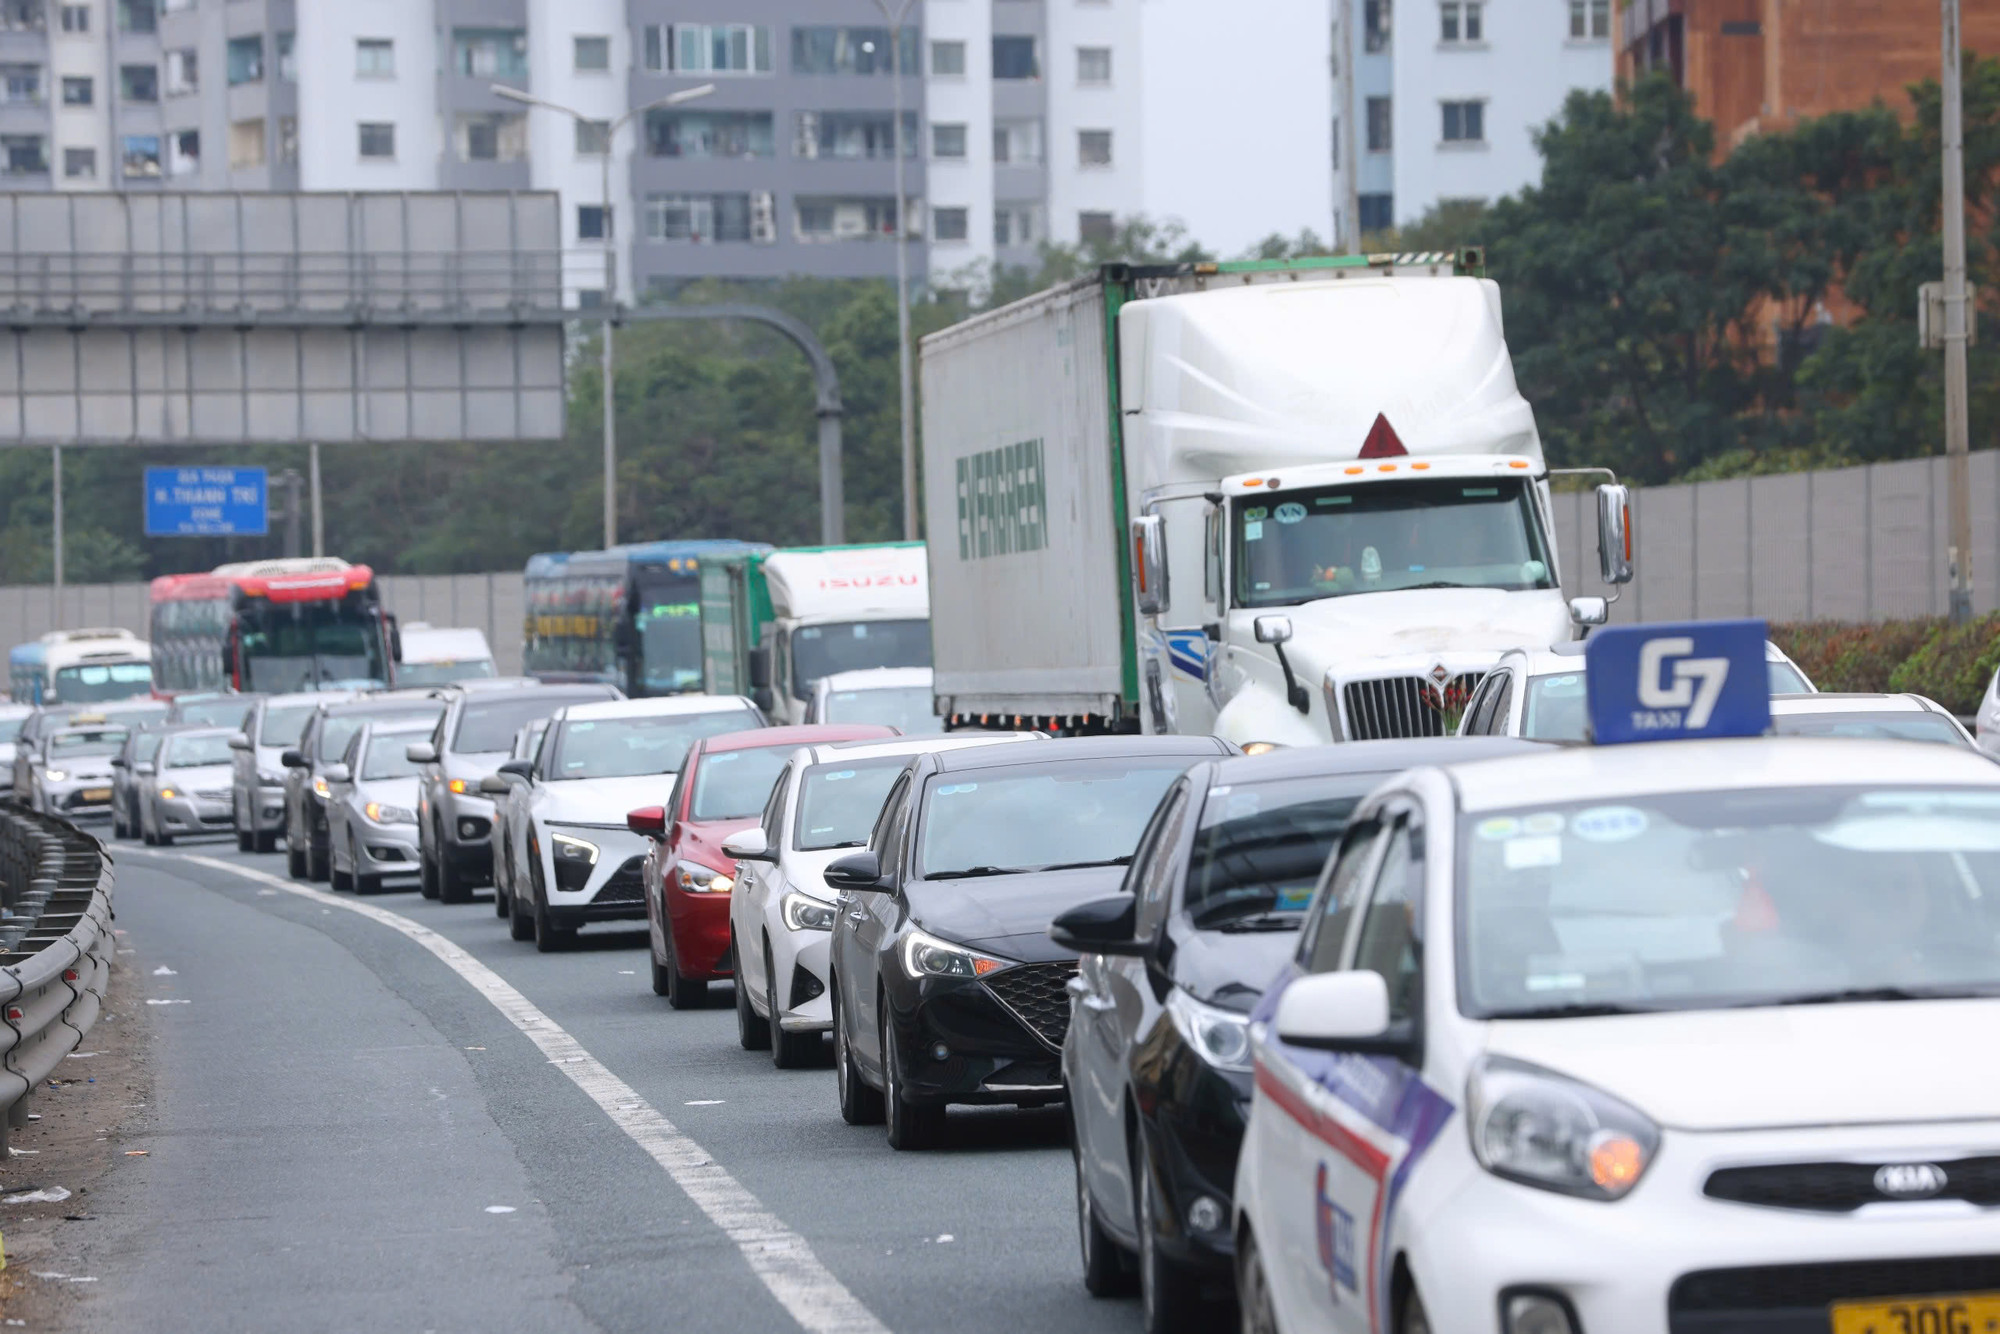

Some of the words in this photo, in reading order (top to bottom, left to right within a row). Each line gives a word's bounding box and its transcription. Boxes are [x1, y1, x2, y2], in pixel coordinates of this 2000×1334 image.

[956, 437, 1048, 561] EVERGREEN
[1280, 507, 1302, 517] VN
[819, 575, 918, 590] ISUZU
[1637, 636, 1730, 729] G7
[1632, 711, 1682, 730] TAXI
[1884, 1165, 1937, 1191] KIA
